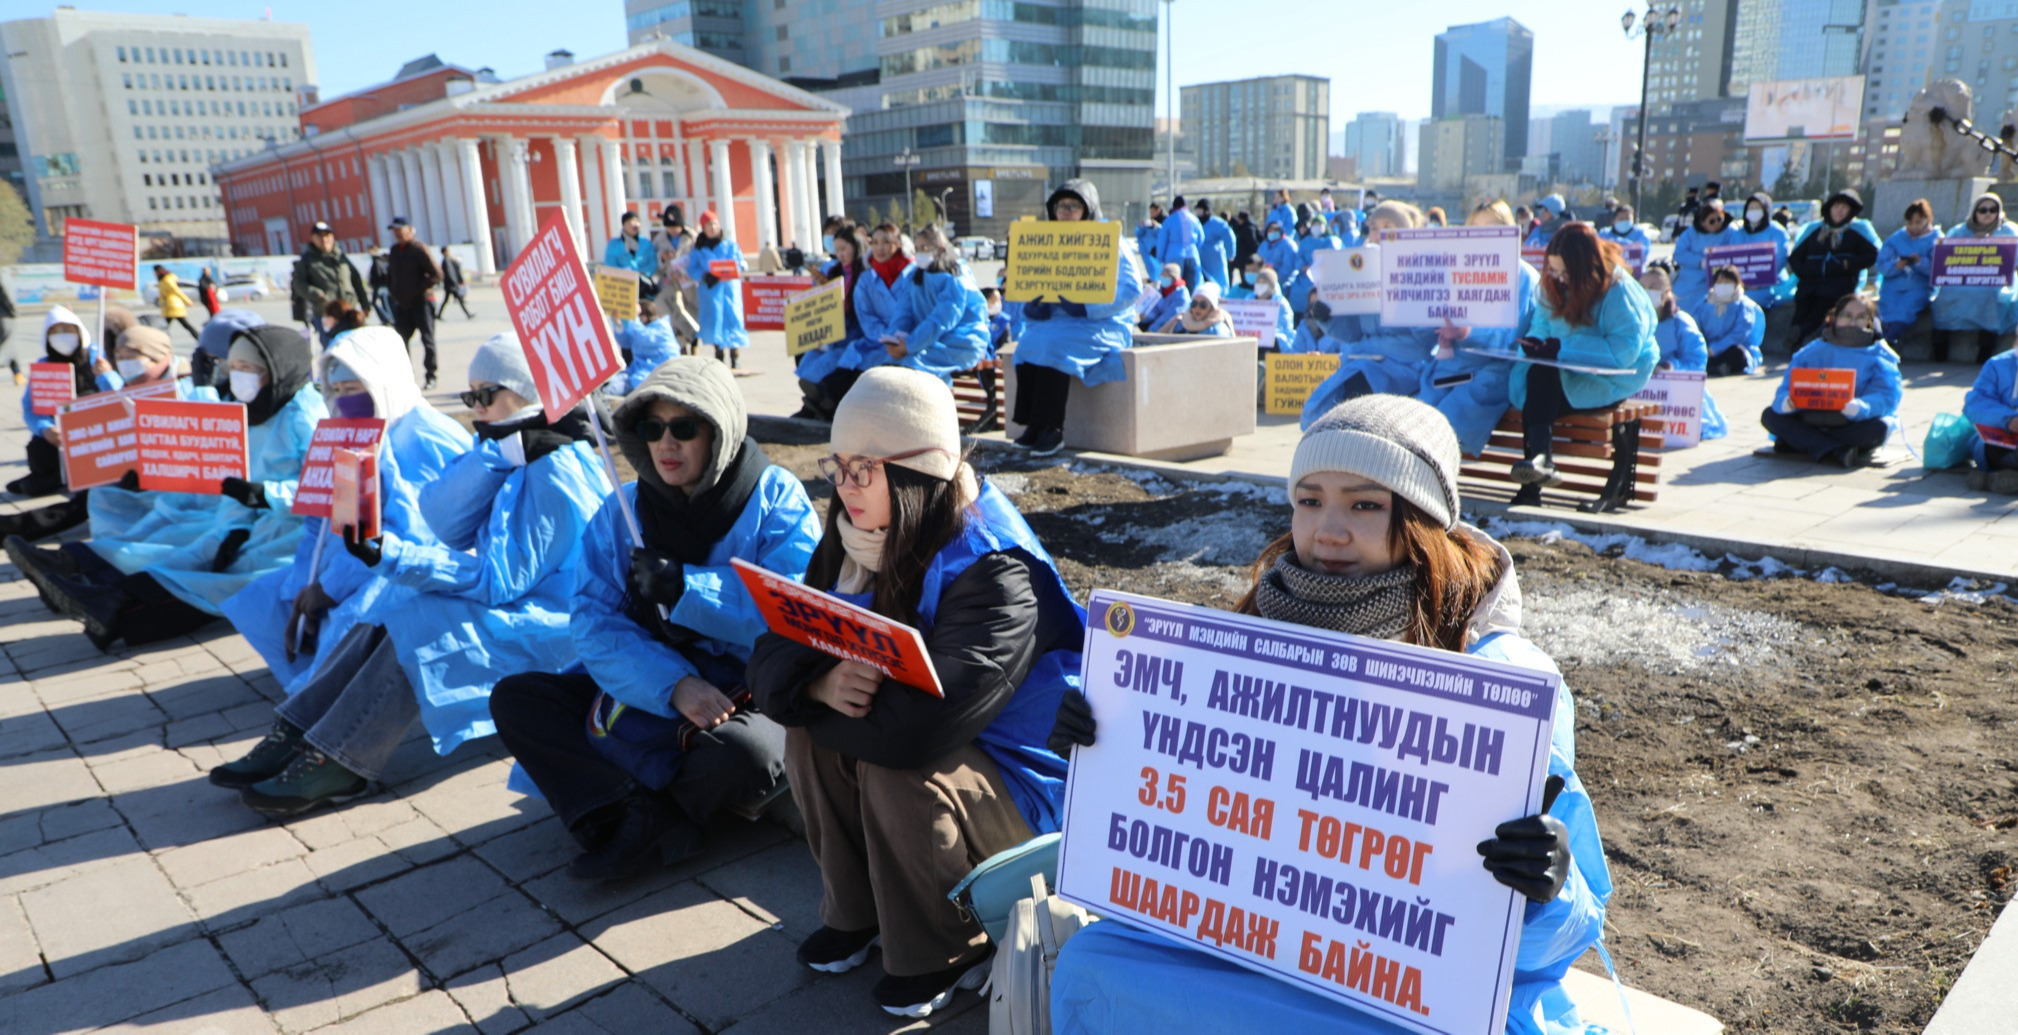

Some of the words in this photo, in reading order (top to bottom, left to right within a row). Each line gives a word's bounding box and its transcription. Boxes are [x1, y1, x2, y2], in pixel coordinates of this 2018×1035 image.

[508, 225, 566, 307] СУВИЛАГЧ
[1016, 264, 1052, 276] ТӨРИЙН
[1055, 265, 1108, 277] БОДЛОГЫГ
[1018, 233, 1054, 247] АЖИЛ
[1058, 232, 1111, 248] ХИЙГЭЭД
[1397, 252, 1457, 268] НИЙГМИЙН
[1464, 253, 1500, 267] ЭРҮҮЛ
[518, 286, 552, 337] РОБОТ
[547, 261, 578, 307] БИШ
[1076, 280, 1107, 291] БАЙНА
[1386, 287, 1450, 301] ҮЙЛЧИЛГЭЭ
[1457, 289, 1511, 303] ХАЯГДАЖ
[1390, 270, 1445, 286] МЭНДИЙН
[1452, 271, 1508, 285] ТУСЛАМЖ
[1427, 304, 1468, 318] БАЙНА!
[530, 292, 608, 411] ХҮН
[1274, 360, 1303, 371] ОЛОН
[139, 414, 199, 430] СУВИЛАГЧ
[769, 589, 903, 659] ЭРҮҮЛ
[1188, 625, 1248, 651] МЭНДИЙН
[1254, 638, 1325, 667] САЛБАРЫН
[1331, 652, 1358, 673] ЗӨВ
[1365, 658, 1474, 697] ШИНЭЧЛЭЛИЙН
[1113, 649, 1188, 706] ЭМЧ,
[1207, 669, 1506, 776] АЖИЛТНУУДЫН
[1142, 710, 1276, 782] ҮНДСЭН
[1295, 748, 1449, 826] ЦАЛИНГ
[1138, 766, 1187, 814] 3.5
[1207, 785, 1275, 841] САЯ
[1297, 808, 1434, 886] ТӨГРӨГ
[1107, 811, 1234, 887] БОЛГОН
[1252, 855, 1456, 957] НЭМЭХИЙГ
[1109, 866, 1280, 960] ШААРДАЖ
[1298, 930, 1430, 1017] БАЙНА.
